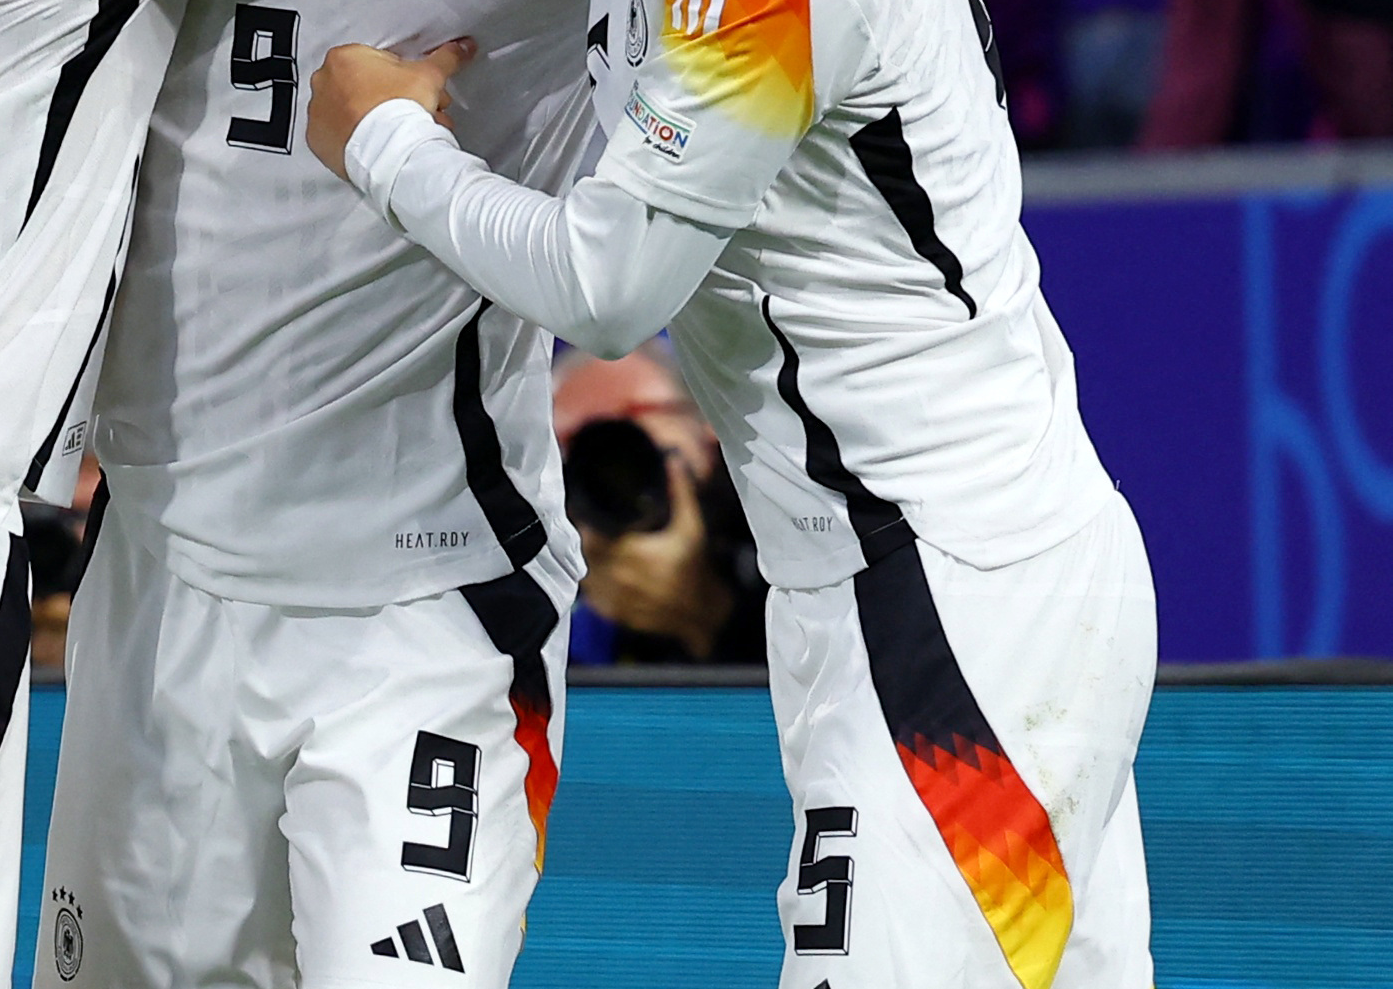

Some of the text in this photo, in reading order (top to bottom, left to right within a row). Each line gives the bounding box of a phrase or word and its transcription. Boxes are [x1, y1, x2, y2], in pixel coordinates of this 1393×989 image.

[226, 3, 301, 156] 9
[395, 531, 469, 549] HEAT.RDY
[401, 730, 482, 884] 9
[793, 806, 858, 956] 5
